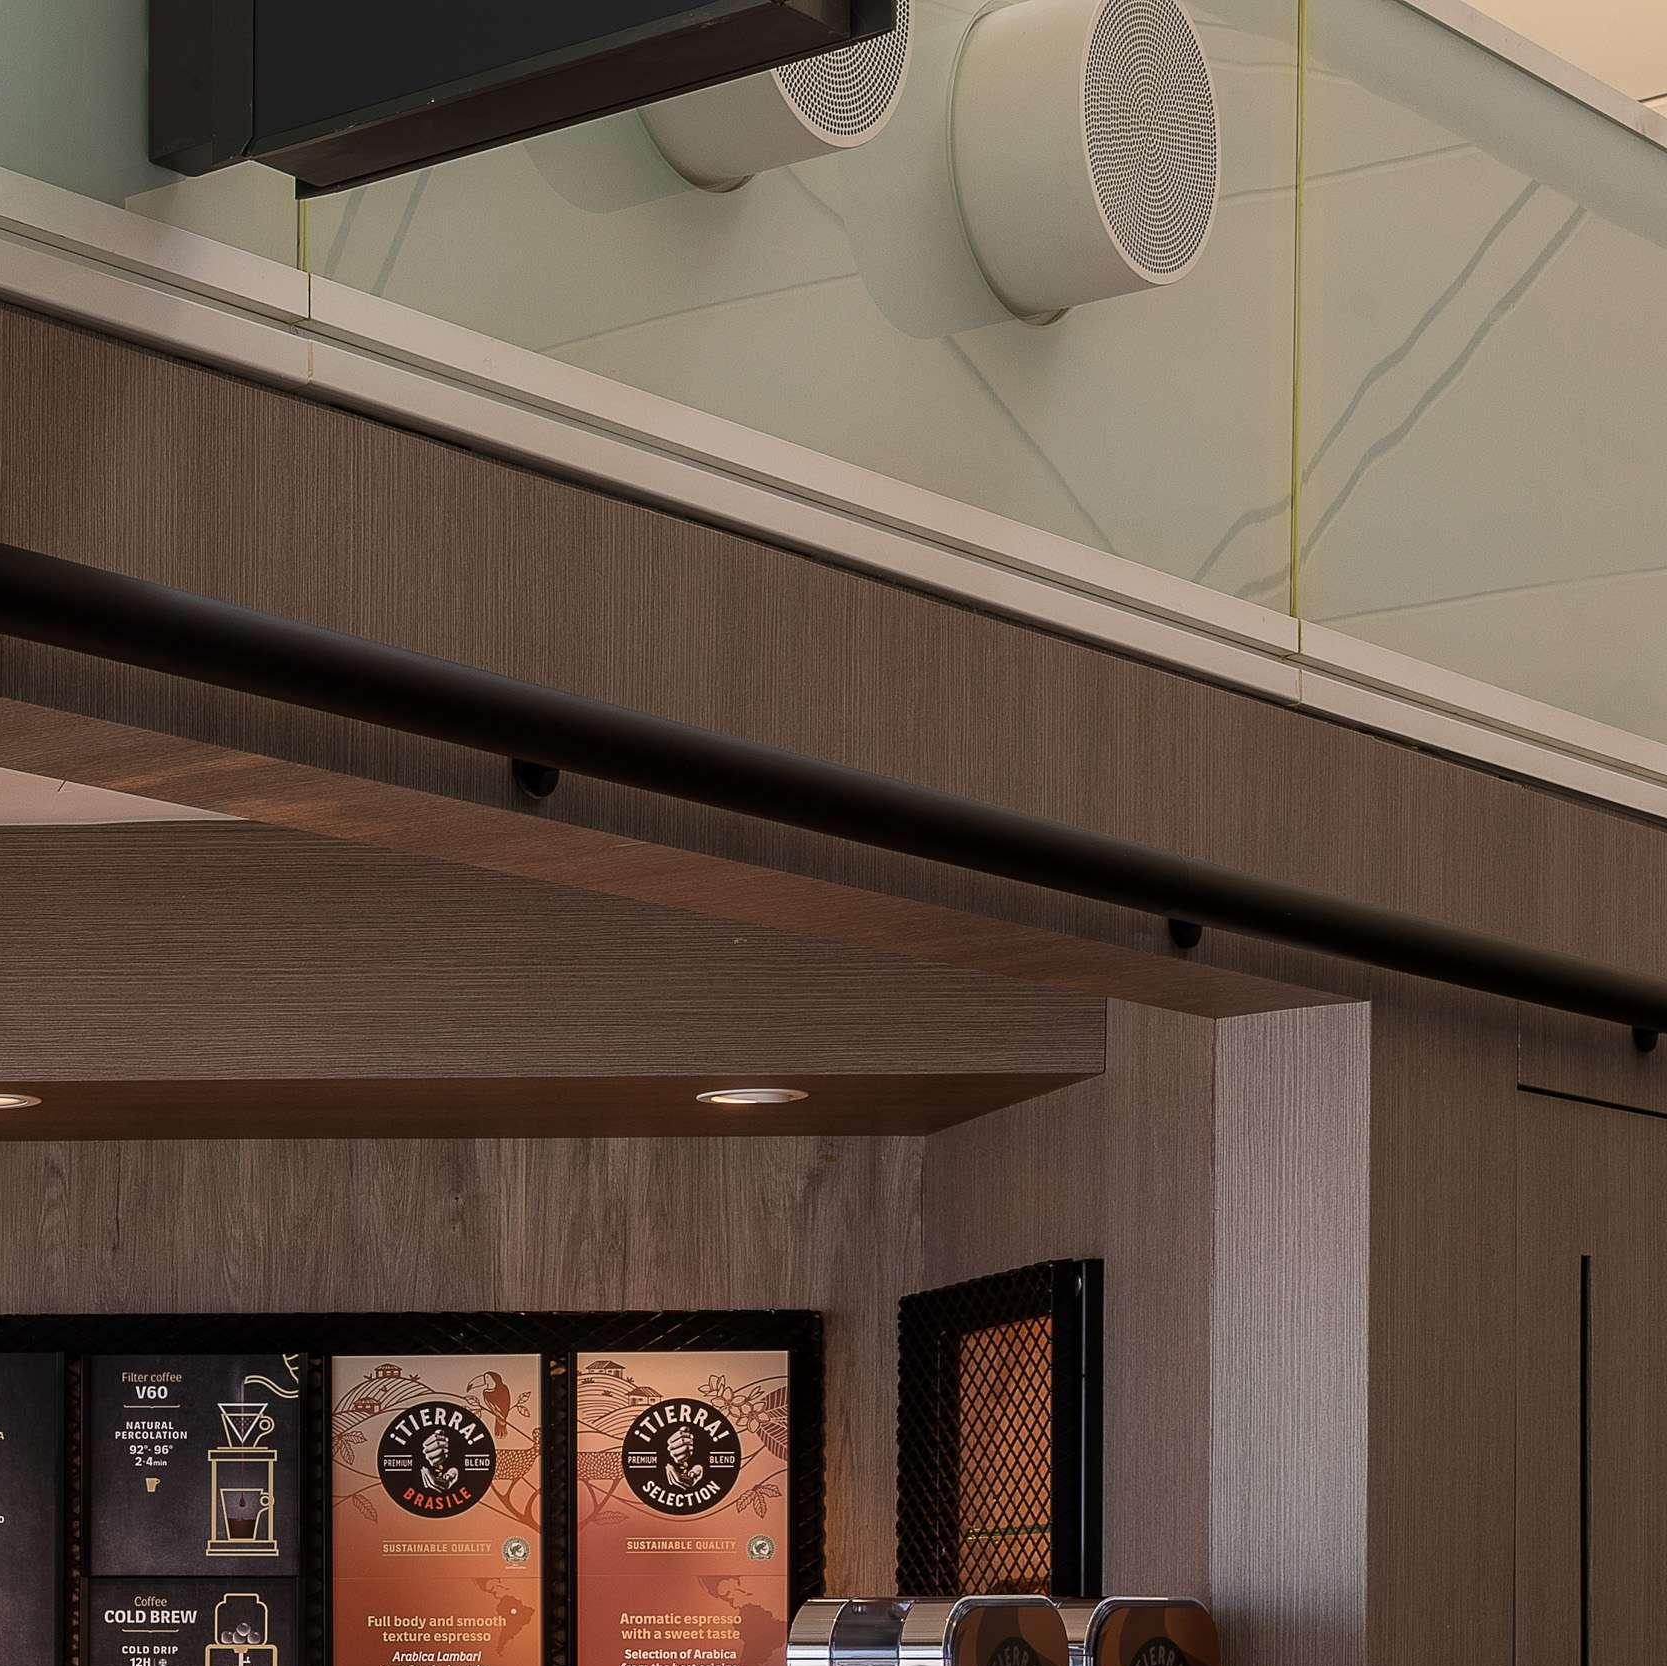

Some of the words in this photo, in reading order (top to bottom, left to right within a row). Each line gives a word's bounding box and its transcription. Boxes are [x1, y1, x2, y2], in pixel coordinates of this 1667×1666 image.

[121, 1371, 148, 1383] Filter
[150, 1371, 182, 1383] coffee
[135, 1385, 168, 1399] V60
[126, 1421, 174, 1430] NATURAL
[115, 1431, 188, 1440] PERCOLATION
[383, 1459, 413, 1467] PREMIUM
[464, 1458, 490, 1467] BLEND
[627, 1456, 658, 1464] PREMIUM
[709, 1455, 735, 1464] BLEND
[403, 1487, 472, 1510] BRASILE
[642, 1480, 721, 1508] SELECTION
[383, 1543, 448, 1553] SUSTAINABLE
[451, 1543, 492, 1553] QUALITY
[626, 1541, 693, 1550] SUSTAINABLE
[695, 1540, 737, 1550] QUALITY
[134, 1596, 167, 1607] Coffee
[104, 1610, 147, 1624] COLD
[150, 1610, 197, 1624] BREW
[367, 1616, 391, 1627] Full
[394, 1616, 426, 1629] body
[429, 1616, 454, 1627] and
[456, 1616, 507, 1627] smooth
[620, 1613, 681, 1625] Aromatic
[684, 1615, 742, 1627] espresso
[383, 1631, 431, 1642] texture
[434, 1633, 491, 1644] espresso
[622, 1628, 651, 1639] with
[653, 1631, 661, 1639] a
[665, 1629, 704, 1639] sweet
[707, 1629, 740, 1639] taste
[121, 1645, 150, 1655] COLD
[153, 1645, 179, 1655] DRIP
[624, 1649, 677, 1659] Selection
[679, 1649, 692, 1659] of
[693, 1649, 737, 1659] Arabica
[392, 1651, 435, 1662] Arabica
[437, 1651, 482, 1662] Lambari
